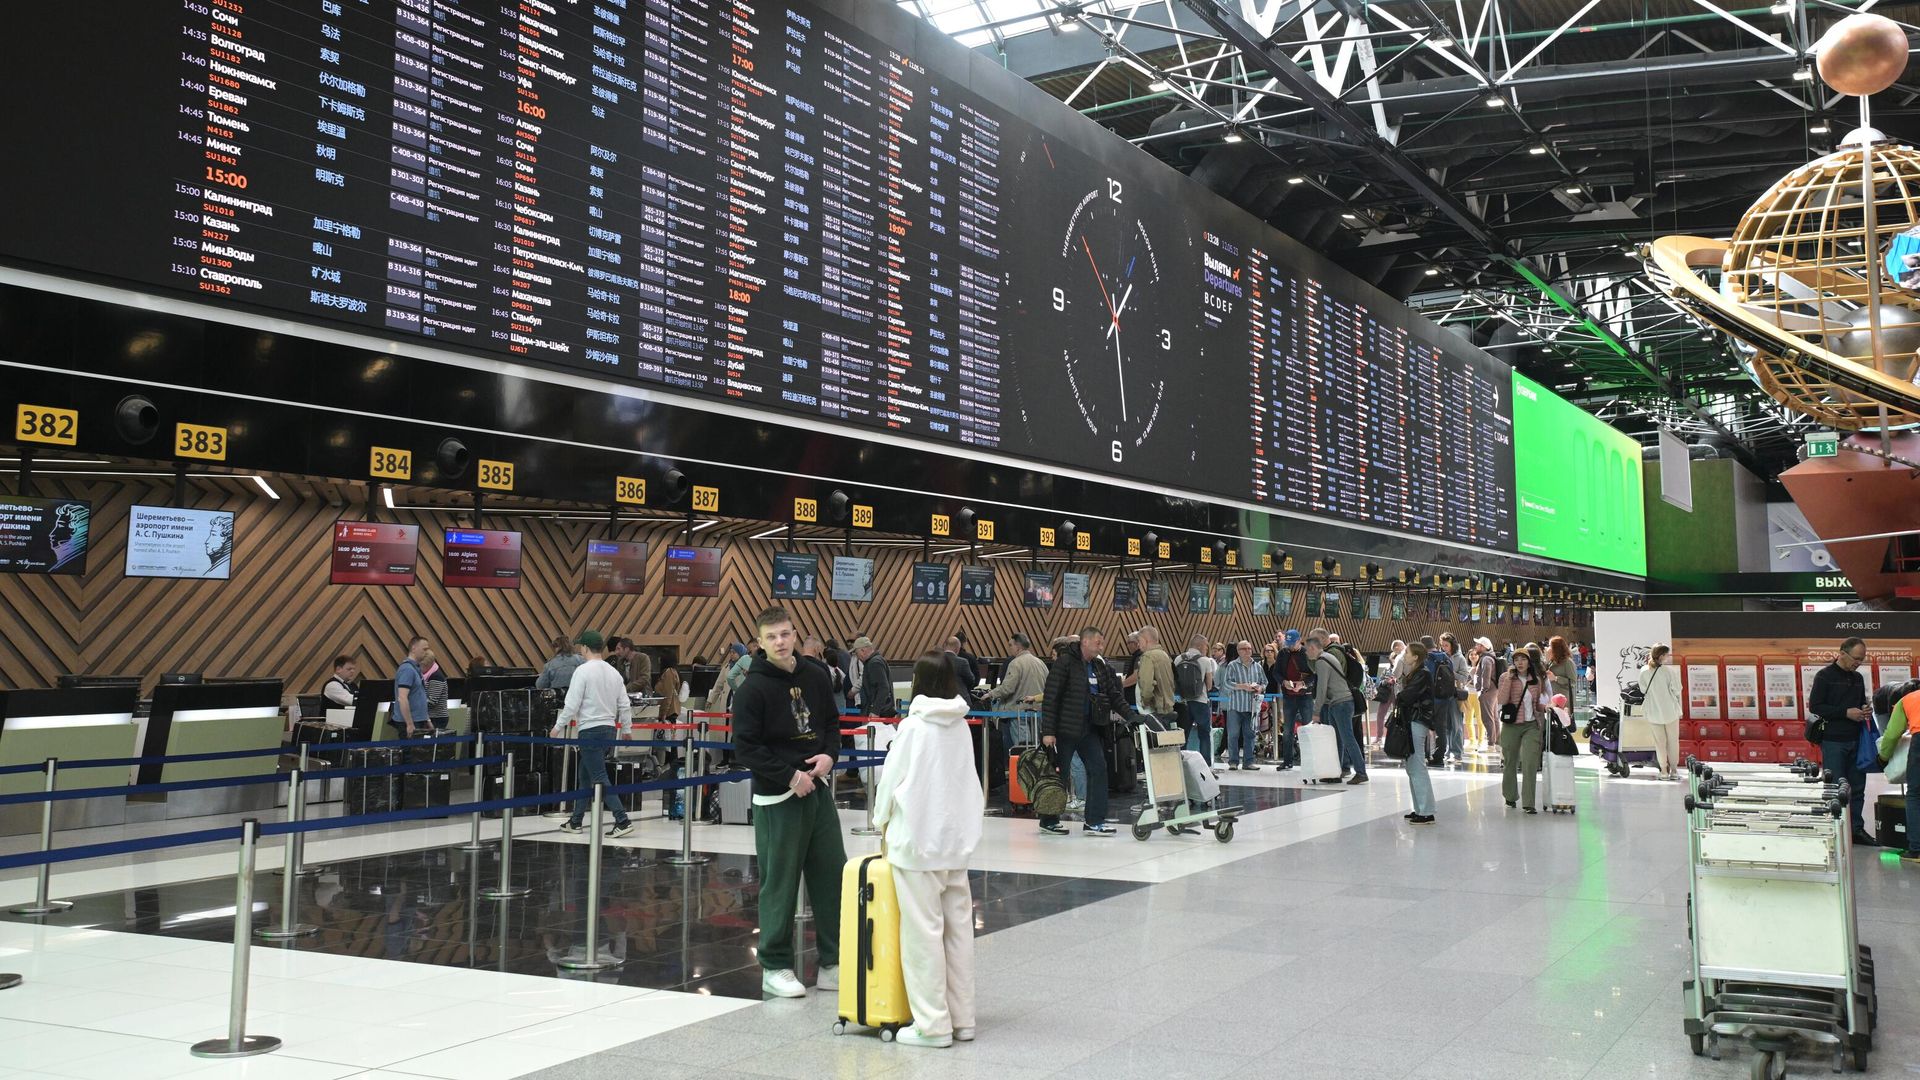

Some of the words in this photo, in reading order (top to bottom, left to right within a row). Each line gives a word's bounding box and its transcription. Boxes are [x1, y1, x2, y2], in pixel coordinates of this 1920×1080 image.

[184, 0, 209, 15] 14:30
[211, 9, 239, 26] Сочи
[402, 10, 430, 27] 319-364
[212, 23, 242, 39] SU1128
[183, 26, 207, 40] 14:35
[211, 34, 265, 63] Волгоград
[402, 33, 430, 50] 408-430
[518, 34, 565, 60] Владивосток
[210, 48, 241, 64] SU1182
[732, 53, 754, 72] 17:00
[182, 52, 206, 66] 14:40
[209, 59, 277, 91] Нижнекамск
[518, 55, 577, 86] Санкт-Петербург
[209, 74, 240, 89] SU1680
[517, 75, 533, 89] Уфа
[181, 79, 205, 92] 14:40
[208, 85, 247, 106] Ереван
[208, 99, 239, 114] SU1862
[517, 100, 546, 120] 16:00
[179, 105, 204, 118] 14:45
[207, 111, 250, 133] Тюмень
[178, 131, 202, 144] 14:45
[206, 137, 241, 156] Минск
[515, 139, 534, 153] Сочи
[206, 151, 237, 166] SU1842
[206, 166, 247, 188] 15:00
[397, 170, 424, 185] 301-302
[514, 182, 540, 197] Казань
[1082, 189, 1098, 206] AIRPORT
[1107, 177, 1122, 204] 12
[176, 184, 200, 197] 15:00
[204, 189, 273, 216] Калининград
[396, 193, 425, 208] 408-430
[203, 203, 235, 217] SU1018
[174, 210, 199, 223] 15:00
[203, 215, 240, 233] Казань
[888, 222, 906, 236] 19:00
[173, 237, 198, 249] 15:05
[201, 255, 233, 269] SU1300
[393, 263, 421, 276] 314-316
[1203, 252, 1232, 278] Вылеты
[171, 264, 197, 276] 15:10
[200, 268, 262, 290] Ставрополь
[1204, 268, 1243, 298] Departures
[200, 282, 231, 295] SU1362
[729, 288, 751, 304] 18:00
[1053, 287, 1064, 311] 9
[1204, 291, 1209, 304] B
[1210, 294, 1215, 307] C
[1216, 297, 1221, 309] D
[1222, 300, 1227, 312] E
[1228, 302, 1233, 314] F
[391, 310, 420, 323] 319-364
[511, 311, 542, 327] Стамбул
[1160, 329, 1171, 350] 3
[21, 410, 74, 440] 382
[179, 428, 223, 455] 383
[1112, 440, 1122, 463] 6
[373, 451, 409, 475] 384
[480, 464, 511, 486] 385
[618, 481, 645, 501] 386
[694, 489, 717, 507] 387
[136, 512, 186, 523] Шереметьево
[796, 502, 816, 518] 388
[854, 508, 872, 525] 389
[135, 522, 170, 531] аэропорт
[933, 517, 949, 532] 390
[979, 523, 993, 537] 391
[152, 531, 184, 540] Пушкина
[1041, 530, 1054, 544] 392
[1077, 534, 1090, 548] 393
[1128, 541, 1140, 552] 394
[1835, 622, 1881, 630] ART-OBJECT
